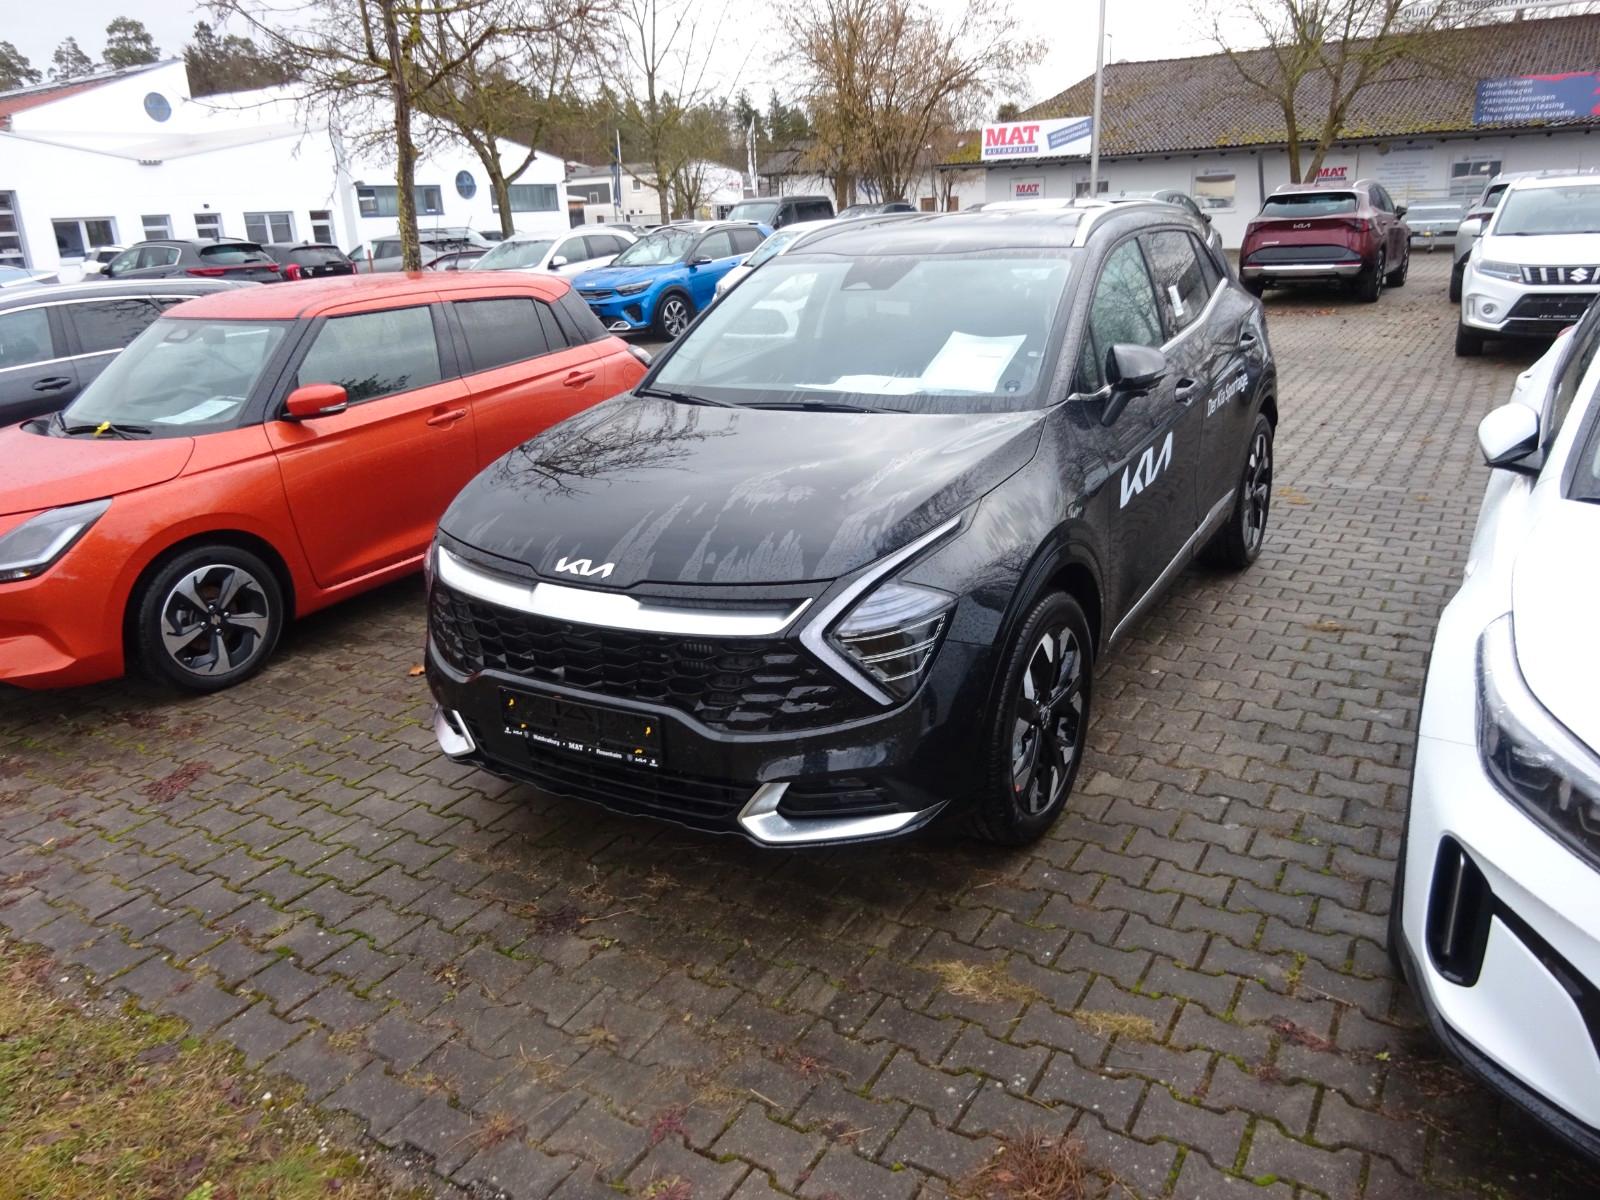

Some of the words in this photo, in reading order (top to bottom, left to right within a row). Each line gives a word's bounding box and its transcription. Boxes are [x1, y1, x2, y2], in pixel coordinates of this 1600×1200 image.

[1485, 87, 1534, 97] Dienstwagen
[1536, 102, 1565, 110] Leasing
[1515, 111, 1542, 120] Monate
[1543, 109, 1576, 118] Garantie
[985, 125, 1040, 147] MAT
[986, 146, 1036, 155] AUTOMOBILE
[1317, 166, 1348, 177] MAT
[1015, 183, 1040, 193] MAT
[1207, 398, 1218, 418] Der
[1217, 389, 1226, 409] Kia
[1225, 373, 1249, 403] Sportage
[1119, 430, 1173, 510] KIA
[554, 556, 615, 579] KIA
[568, 741, 584, 752] MAT
